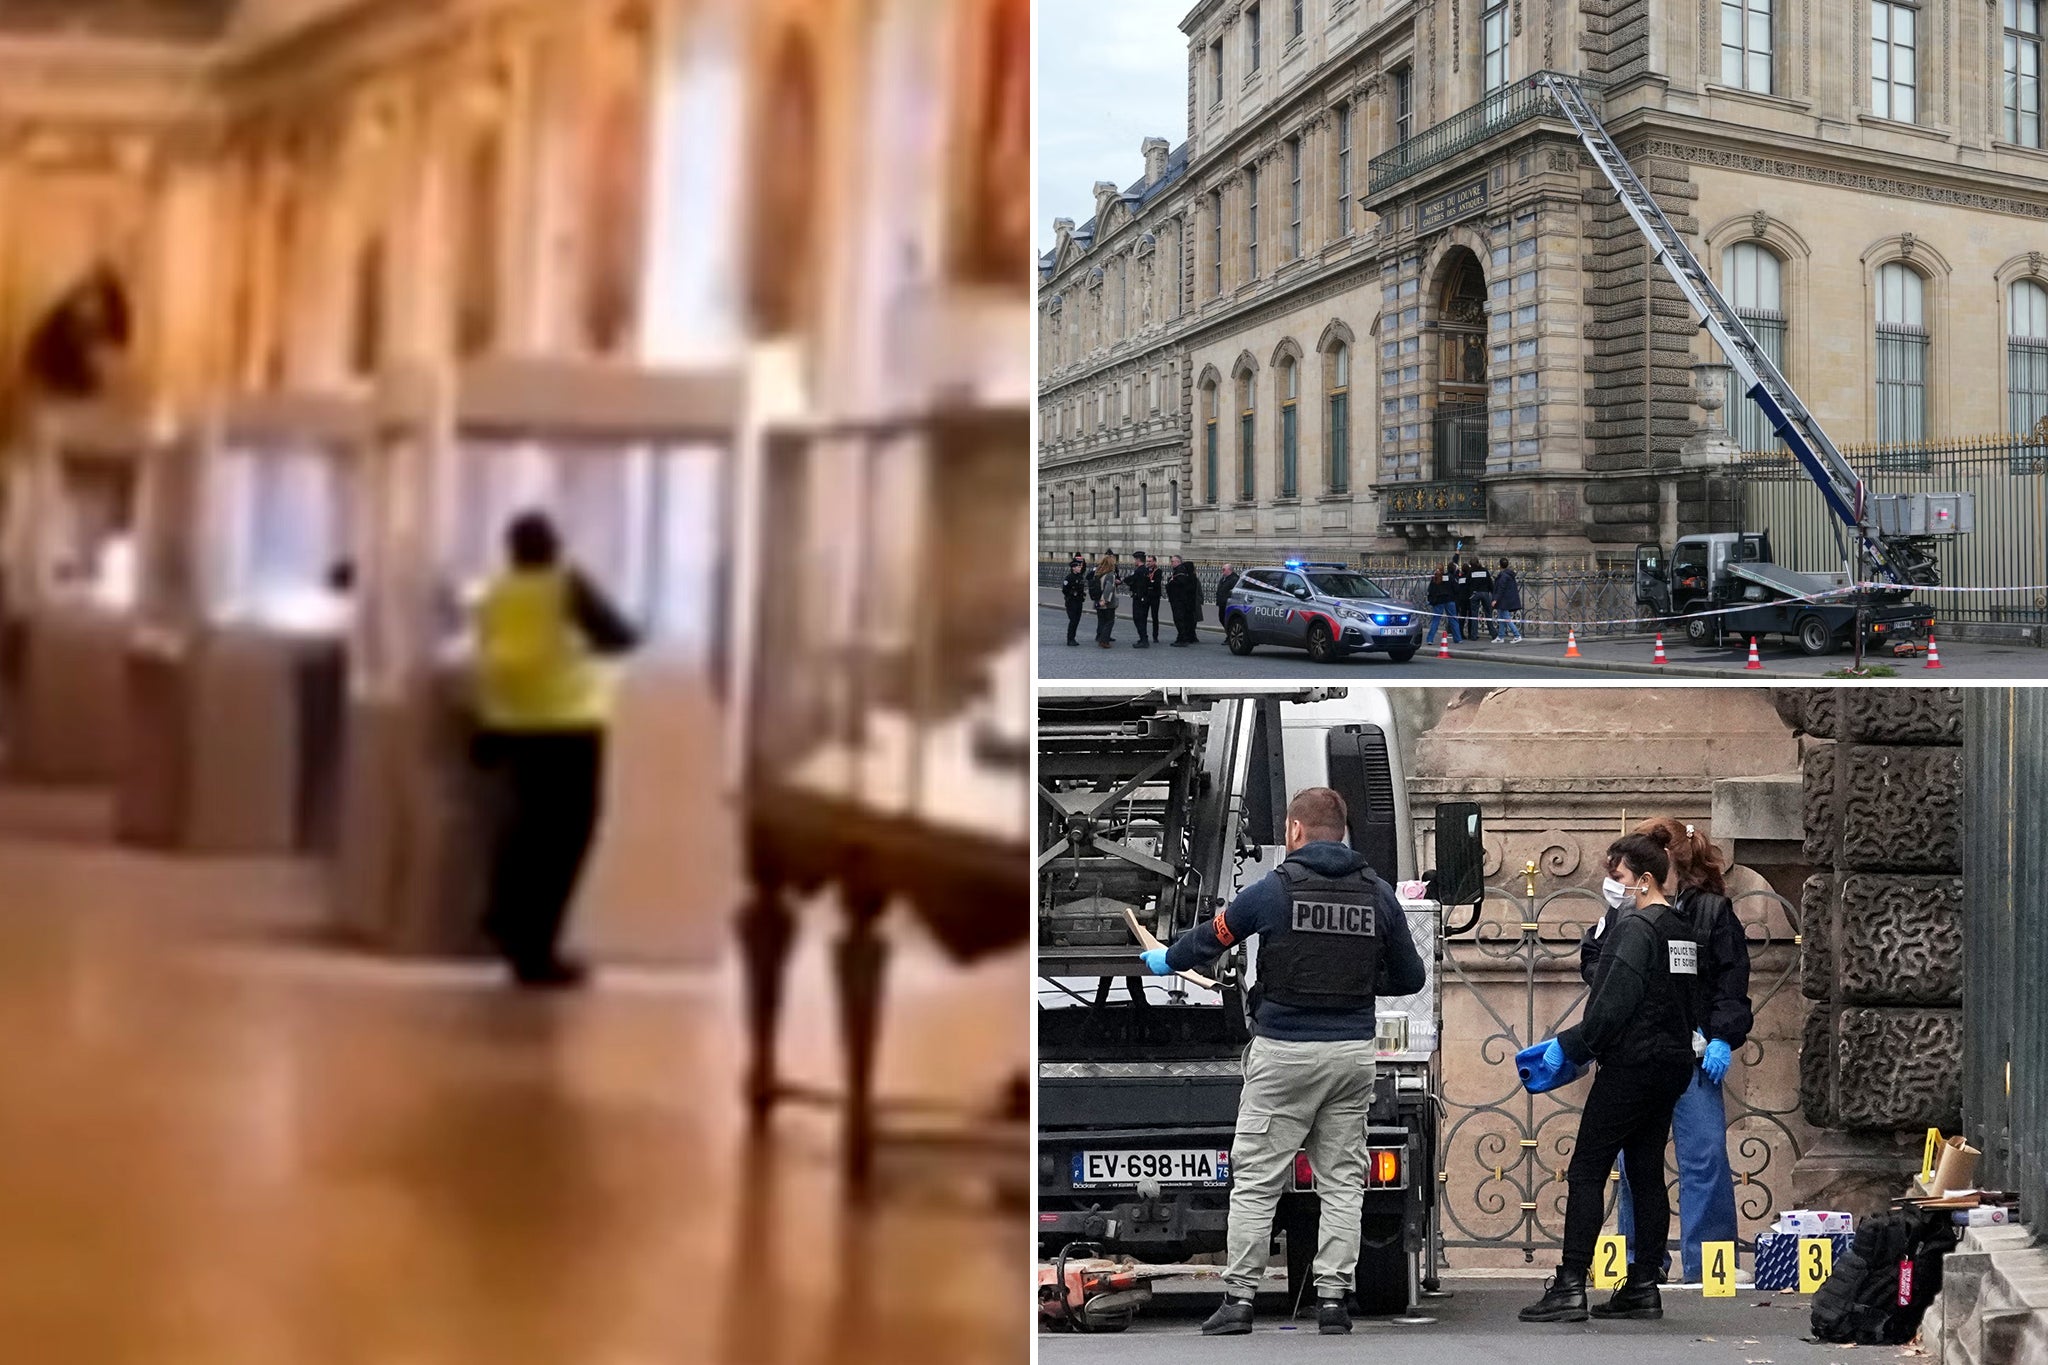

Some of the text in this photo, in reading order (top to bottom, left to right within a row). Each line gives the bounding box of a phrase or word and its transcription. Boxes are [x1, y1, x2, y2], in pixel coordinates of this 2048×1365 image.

[1447, 196, 1455, 207] DU
[1458, 185, 1481, 203] LOUVRE
[1423, 196, 1484, 227] GALERIES DES ANTIQUES
[1255, 606, 1284, 618] POLICE
[1297, 903, 1373, 933] POLICE
[1670, 946, 1688, 956] POLICE
[1674, 958, 1681, 967] ET
[1074, 1154, 1229, 1178] F EV-698-HA 75
[1603, 1241, 1618, 1277] 2
[1711, 1249, 1726, 1285] 4
[1808, 1243, 1823, 1281] 3
